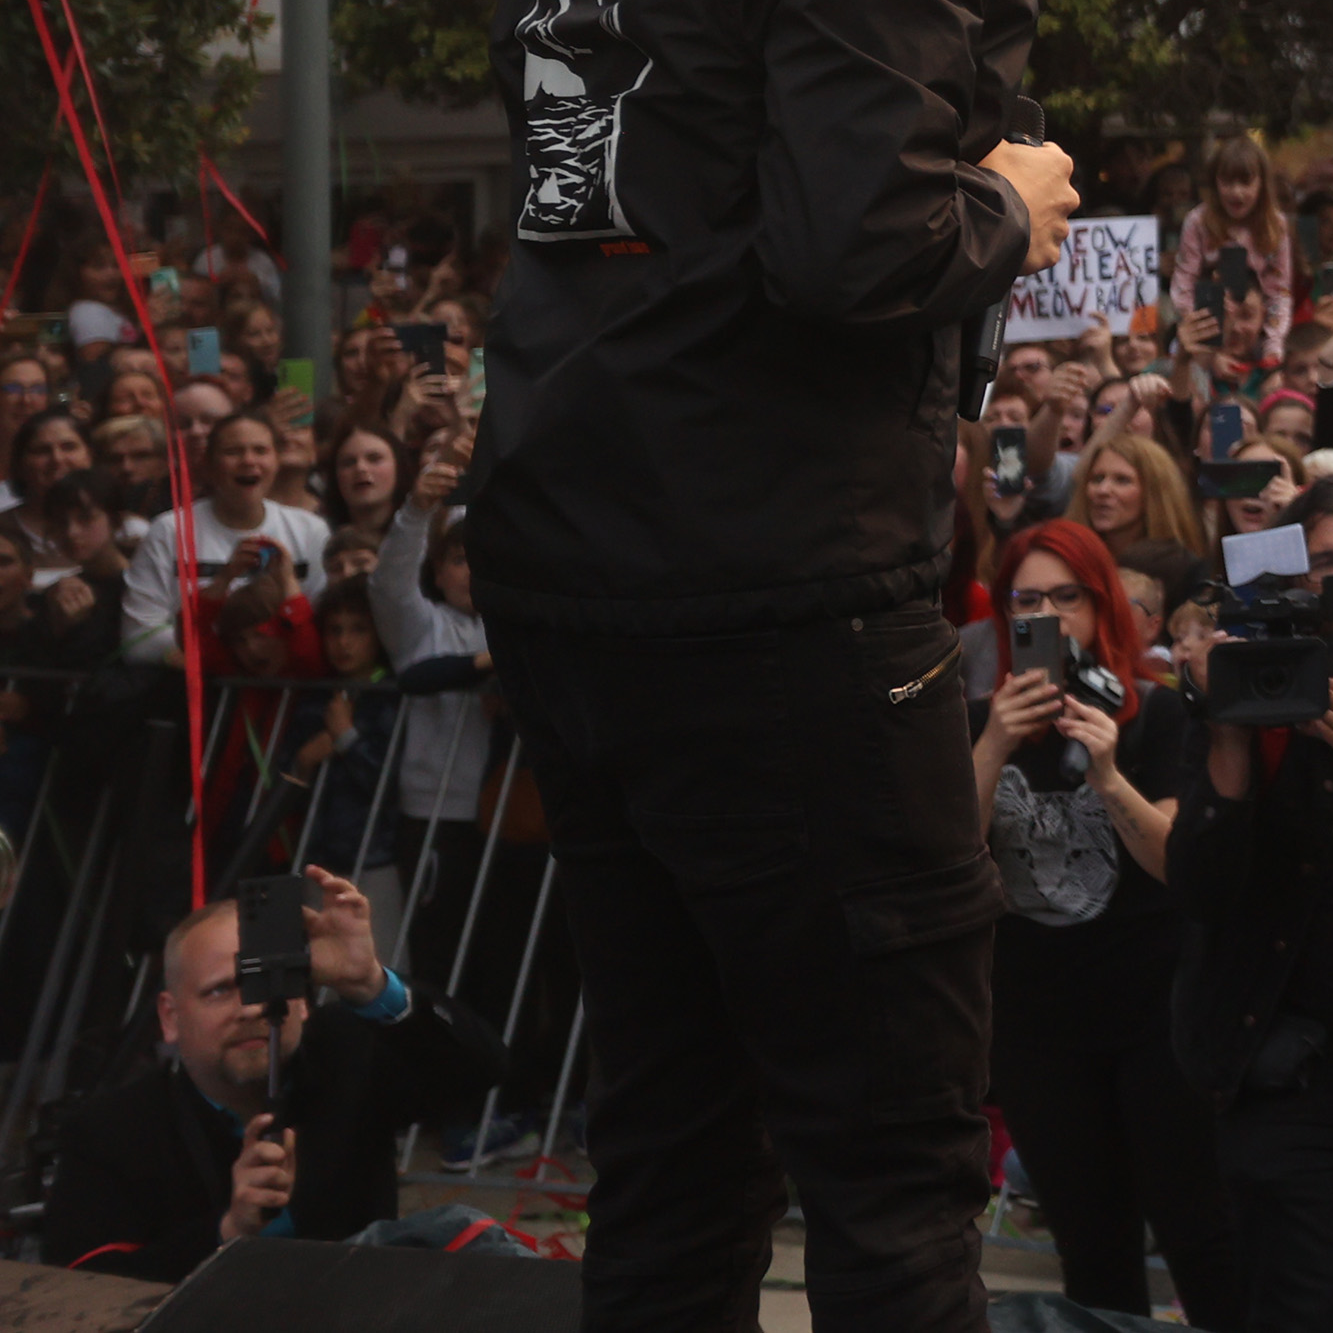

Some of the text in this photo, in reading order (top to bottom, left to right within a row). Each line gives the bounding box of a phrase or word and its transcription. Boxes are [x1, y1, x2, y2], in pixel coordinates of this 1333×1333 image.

[1069, 246, 1158, 283] PLEASE
[1007, 287, 1088, 322] MEOW
[1095, 273, 1147, 316] BACK
